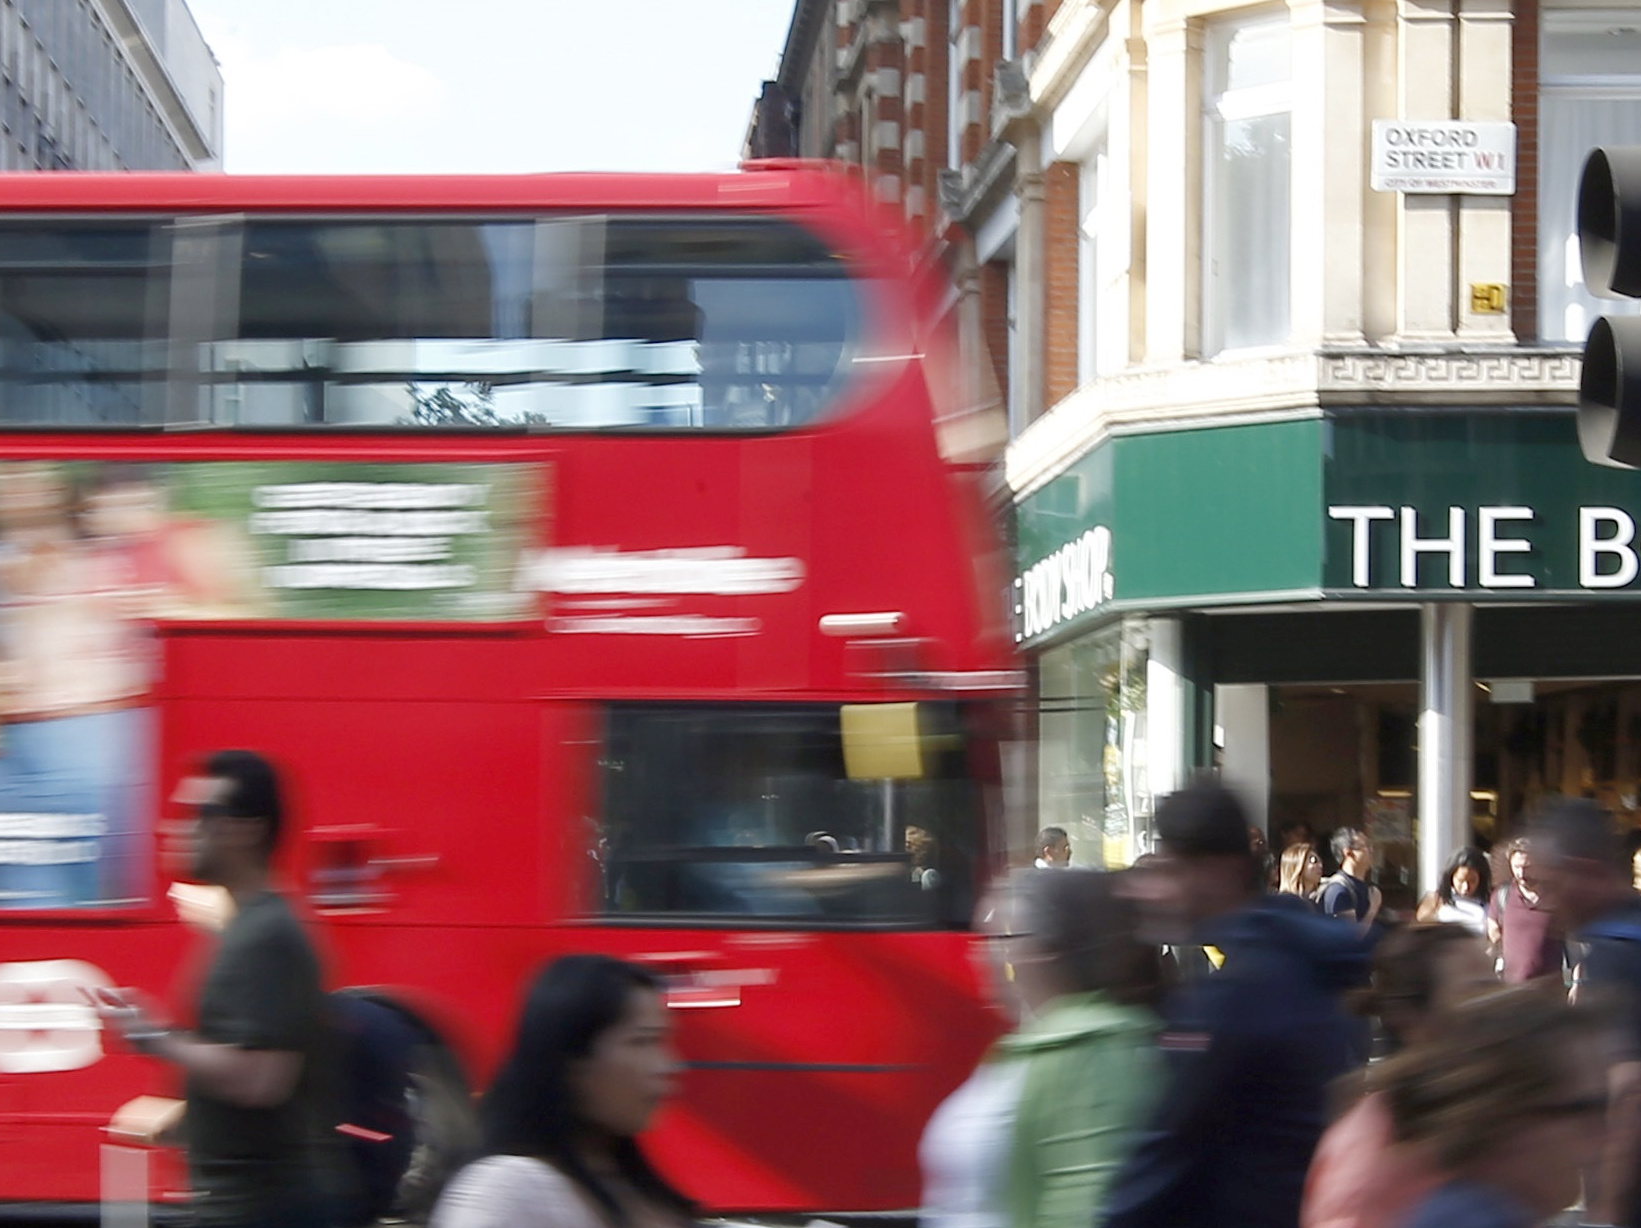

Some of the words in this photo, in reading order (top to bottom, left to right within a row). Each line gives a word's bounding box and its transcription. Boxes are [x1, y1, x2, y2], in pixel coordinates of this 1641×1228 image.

[1385, 128, 1478, 147] OXFORD
[1385, 151, 1469, 169] STREET
[1328, 505, 1535, 588] THE
